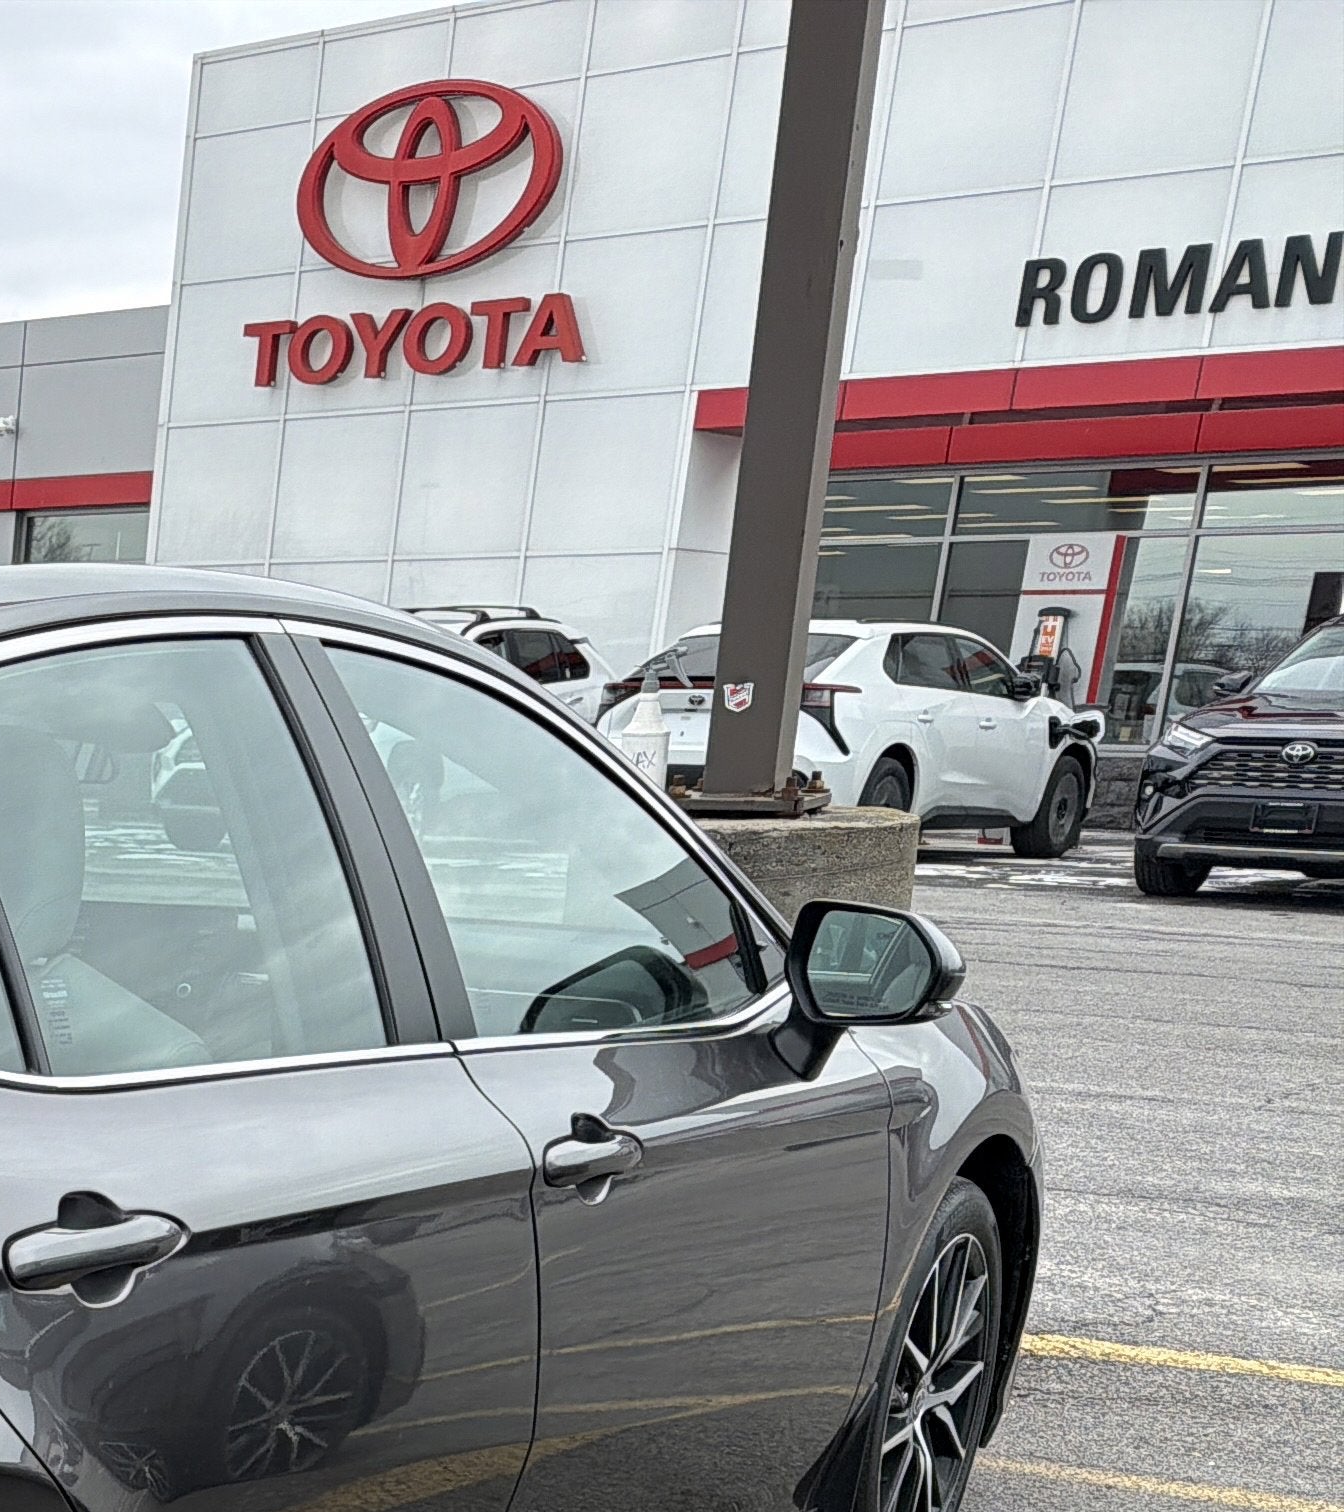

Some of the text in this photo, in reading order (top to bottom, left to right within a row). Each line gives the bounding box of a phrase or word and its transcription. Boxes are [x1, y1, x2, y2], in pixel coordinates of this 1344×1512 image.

[1014, 231, 1344, 328] ROMAN
[244, 293, 586, 388] TOYOTA
[1039, 570, 1092, 582] TOYOTA
